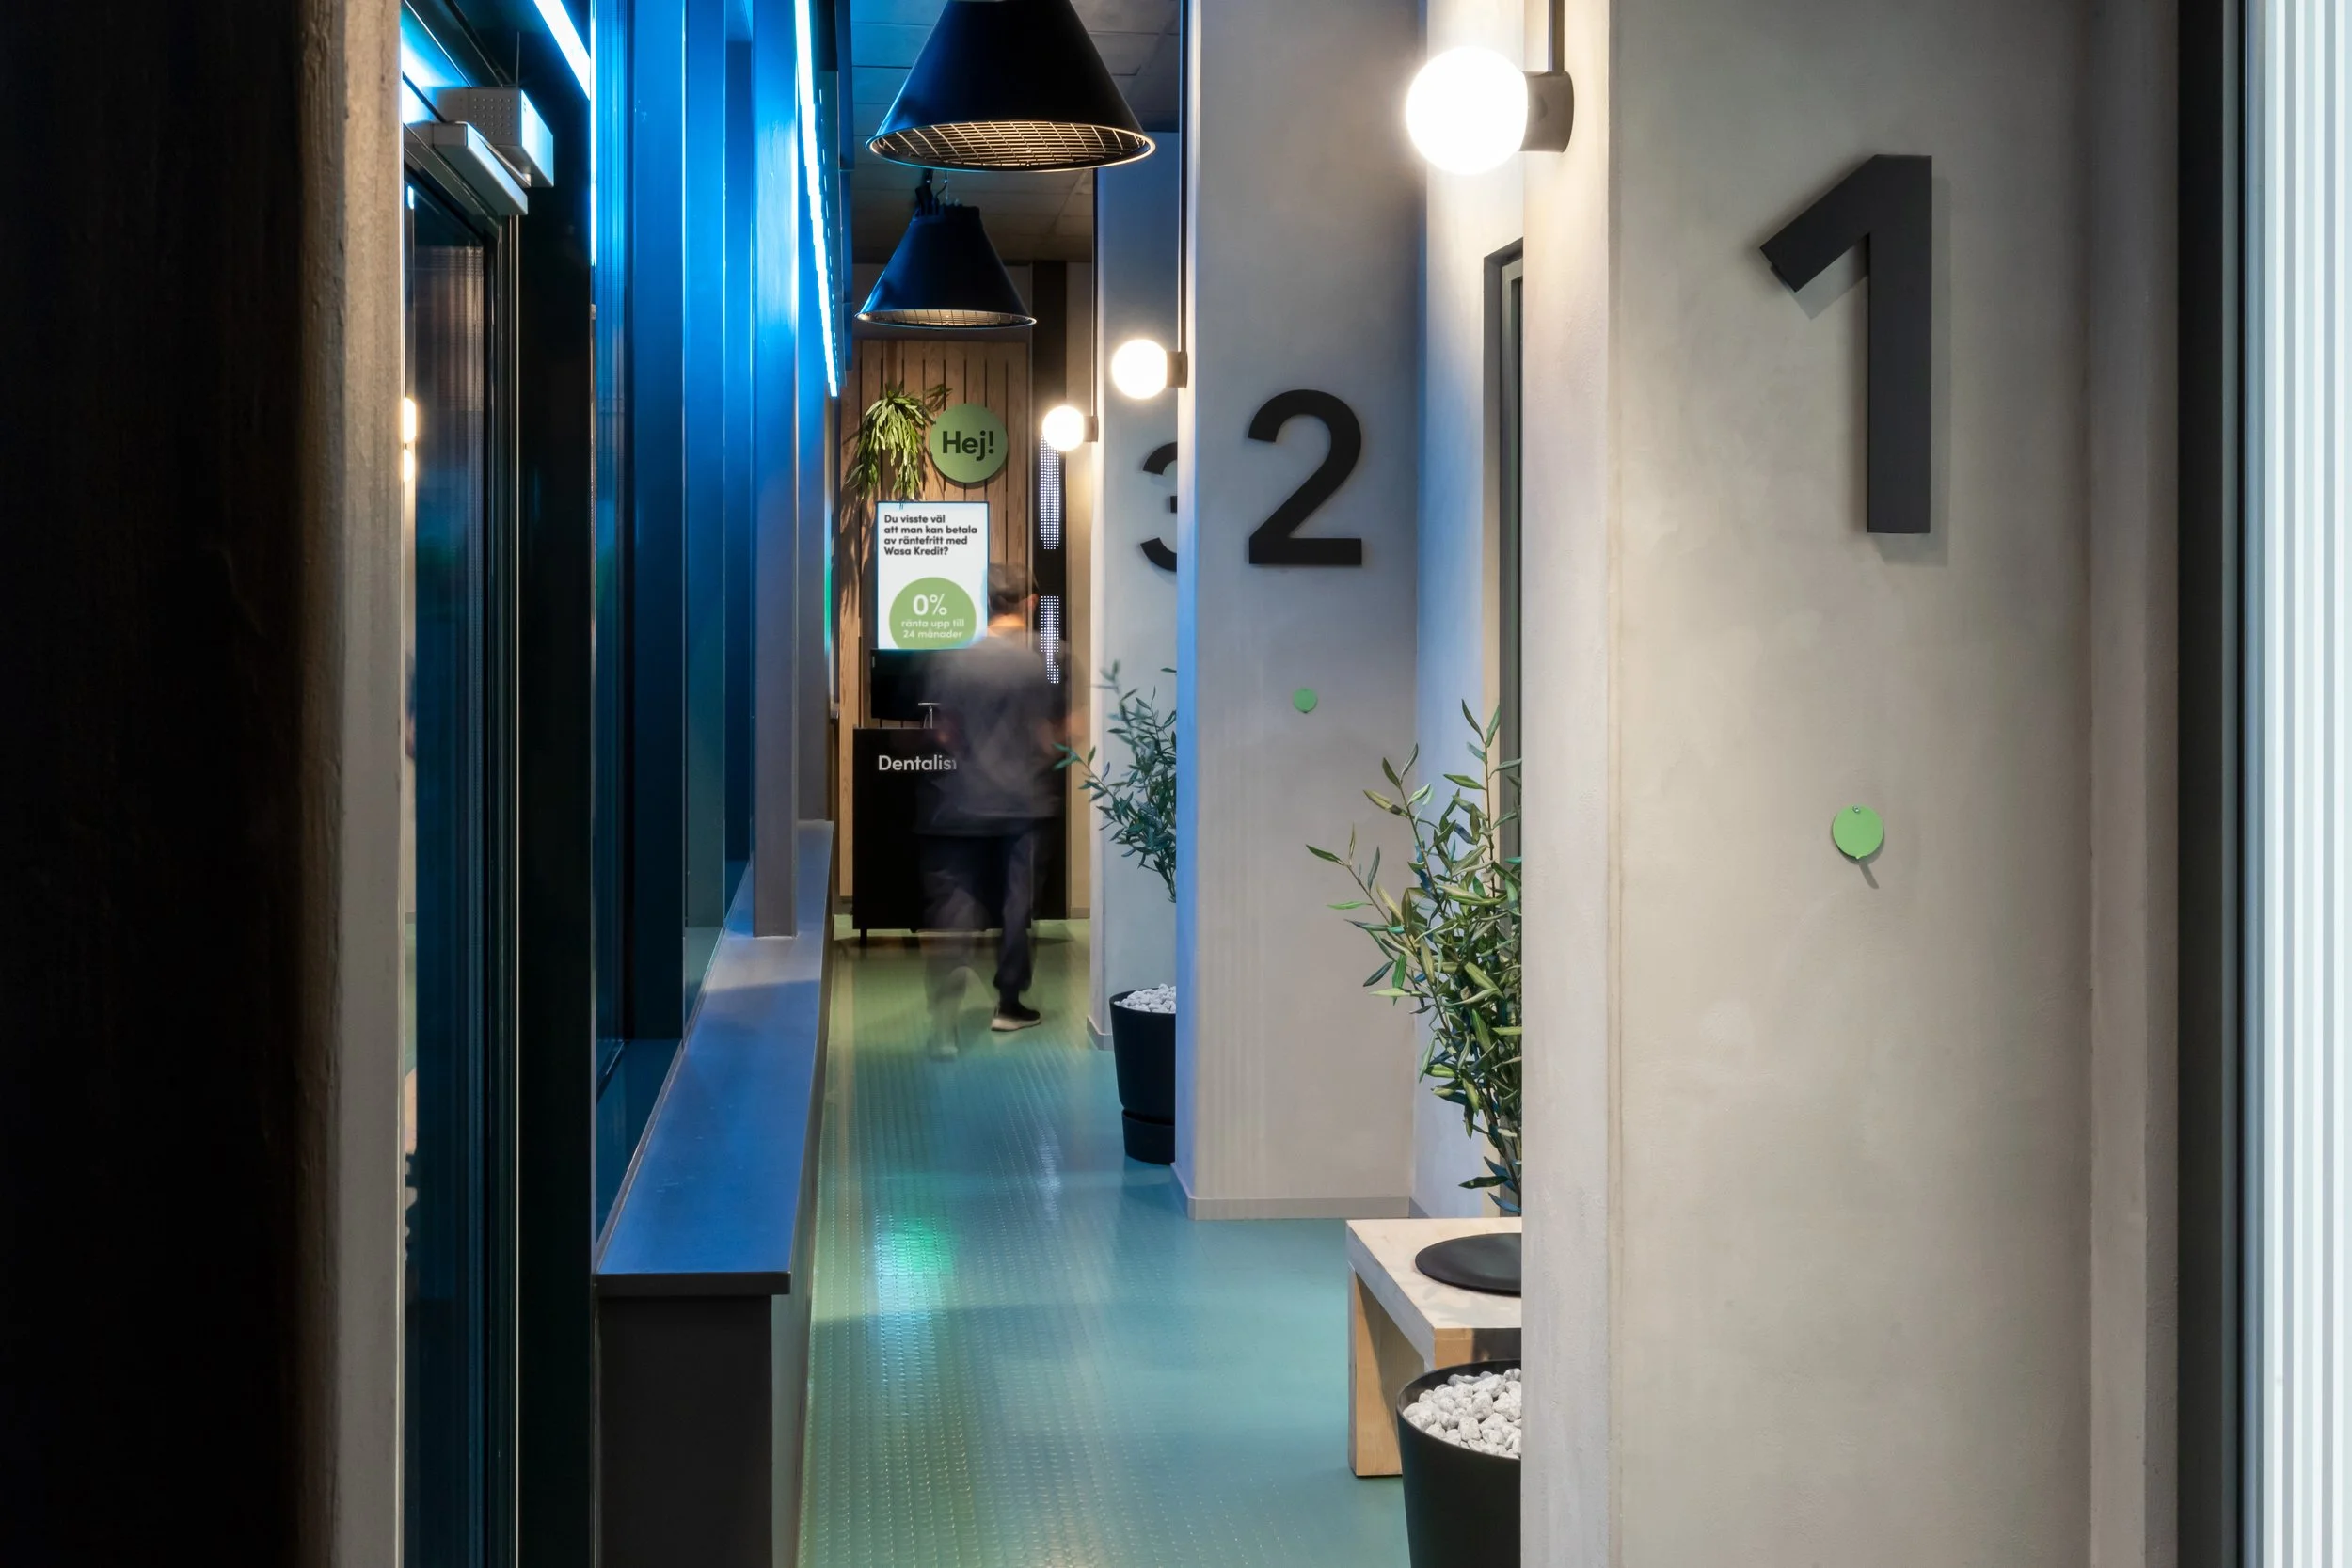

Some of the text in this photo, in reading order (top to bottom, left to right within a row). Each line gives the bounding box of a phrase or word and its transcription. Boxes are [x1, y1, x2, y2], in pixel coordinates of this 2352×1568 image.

[1759, 154, 1932, 533] 1
[942, 430, 994, 462] Hej!
[1248, 388, 1362, 566] 2
[884, 515, 946, 523] Du visste väl
[883, 525, 977, 534] att man kan betala
[898, 536, 944, 545] räntefritt
[946, 536, 968, 545] med
[883, 546, 949, 556] Wasa Kredit?
[913, 594, 948, 616] 0%
[901, 619, 965, 629] ränta upp till
[902, 628, 963, 638] 24 månader
